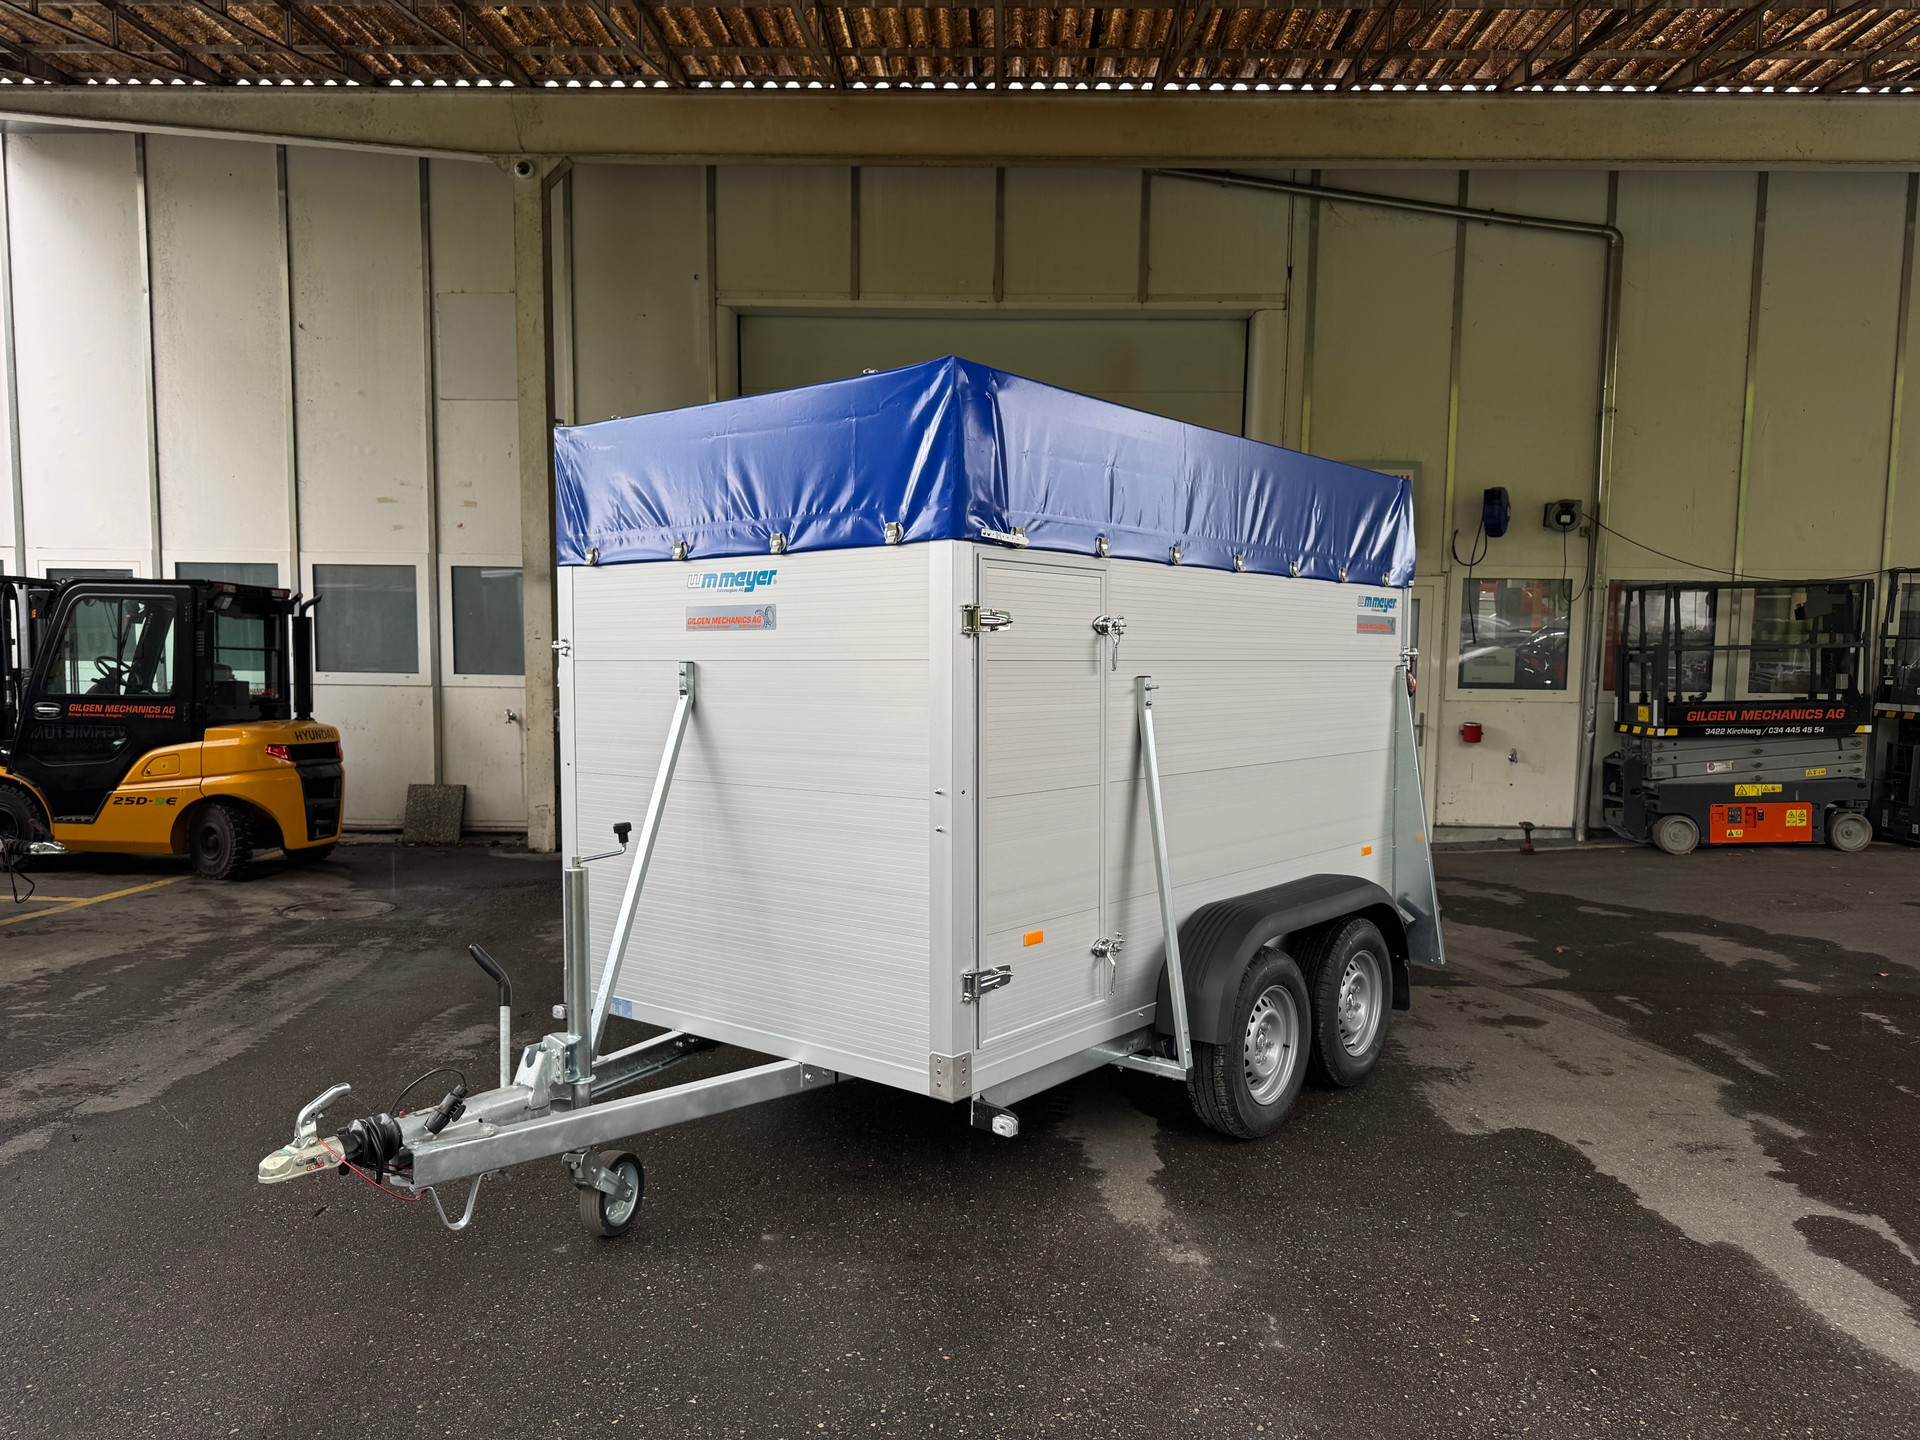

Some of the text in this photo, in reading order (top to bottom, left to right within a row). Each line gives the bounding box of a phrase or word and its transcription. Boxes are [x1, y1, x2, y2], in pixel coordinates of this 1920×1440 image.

[687, 615, 762, 625] GILGEN MECHANICS AG
[69, 703, 176, 715] GILGEN MECHANICS AG
[1686, 708, 1846, 722] GILGEN MECHANICS AG
[295, 728, 335, 741] HYUNDAI
[1705, 727, 1726, 735] 3422
[1727, 727, 1761, 736] Kirchberg
[1785, 726, 1800, 734] 445
[1801, 726, 1813, 734] 45
